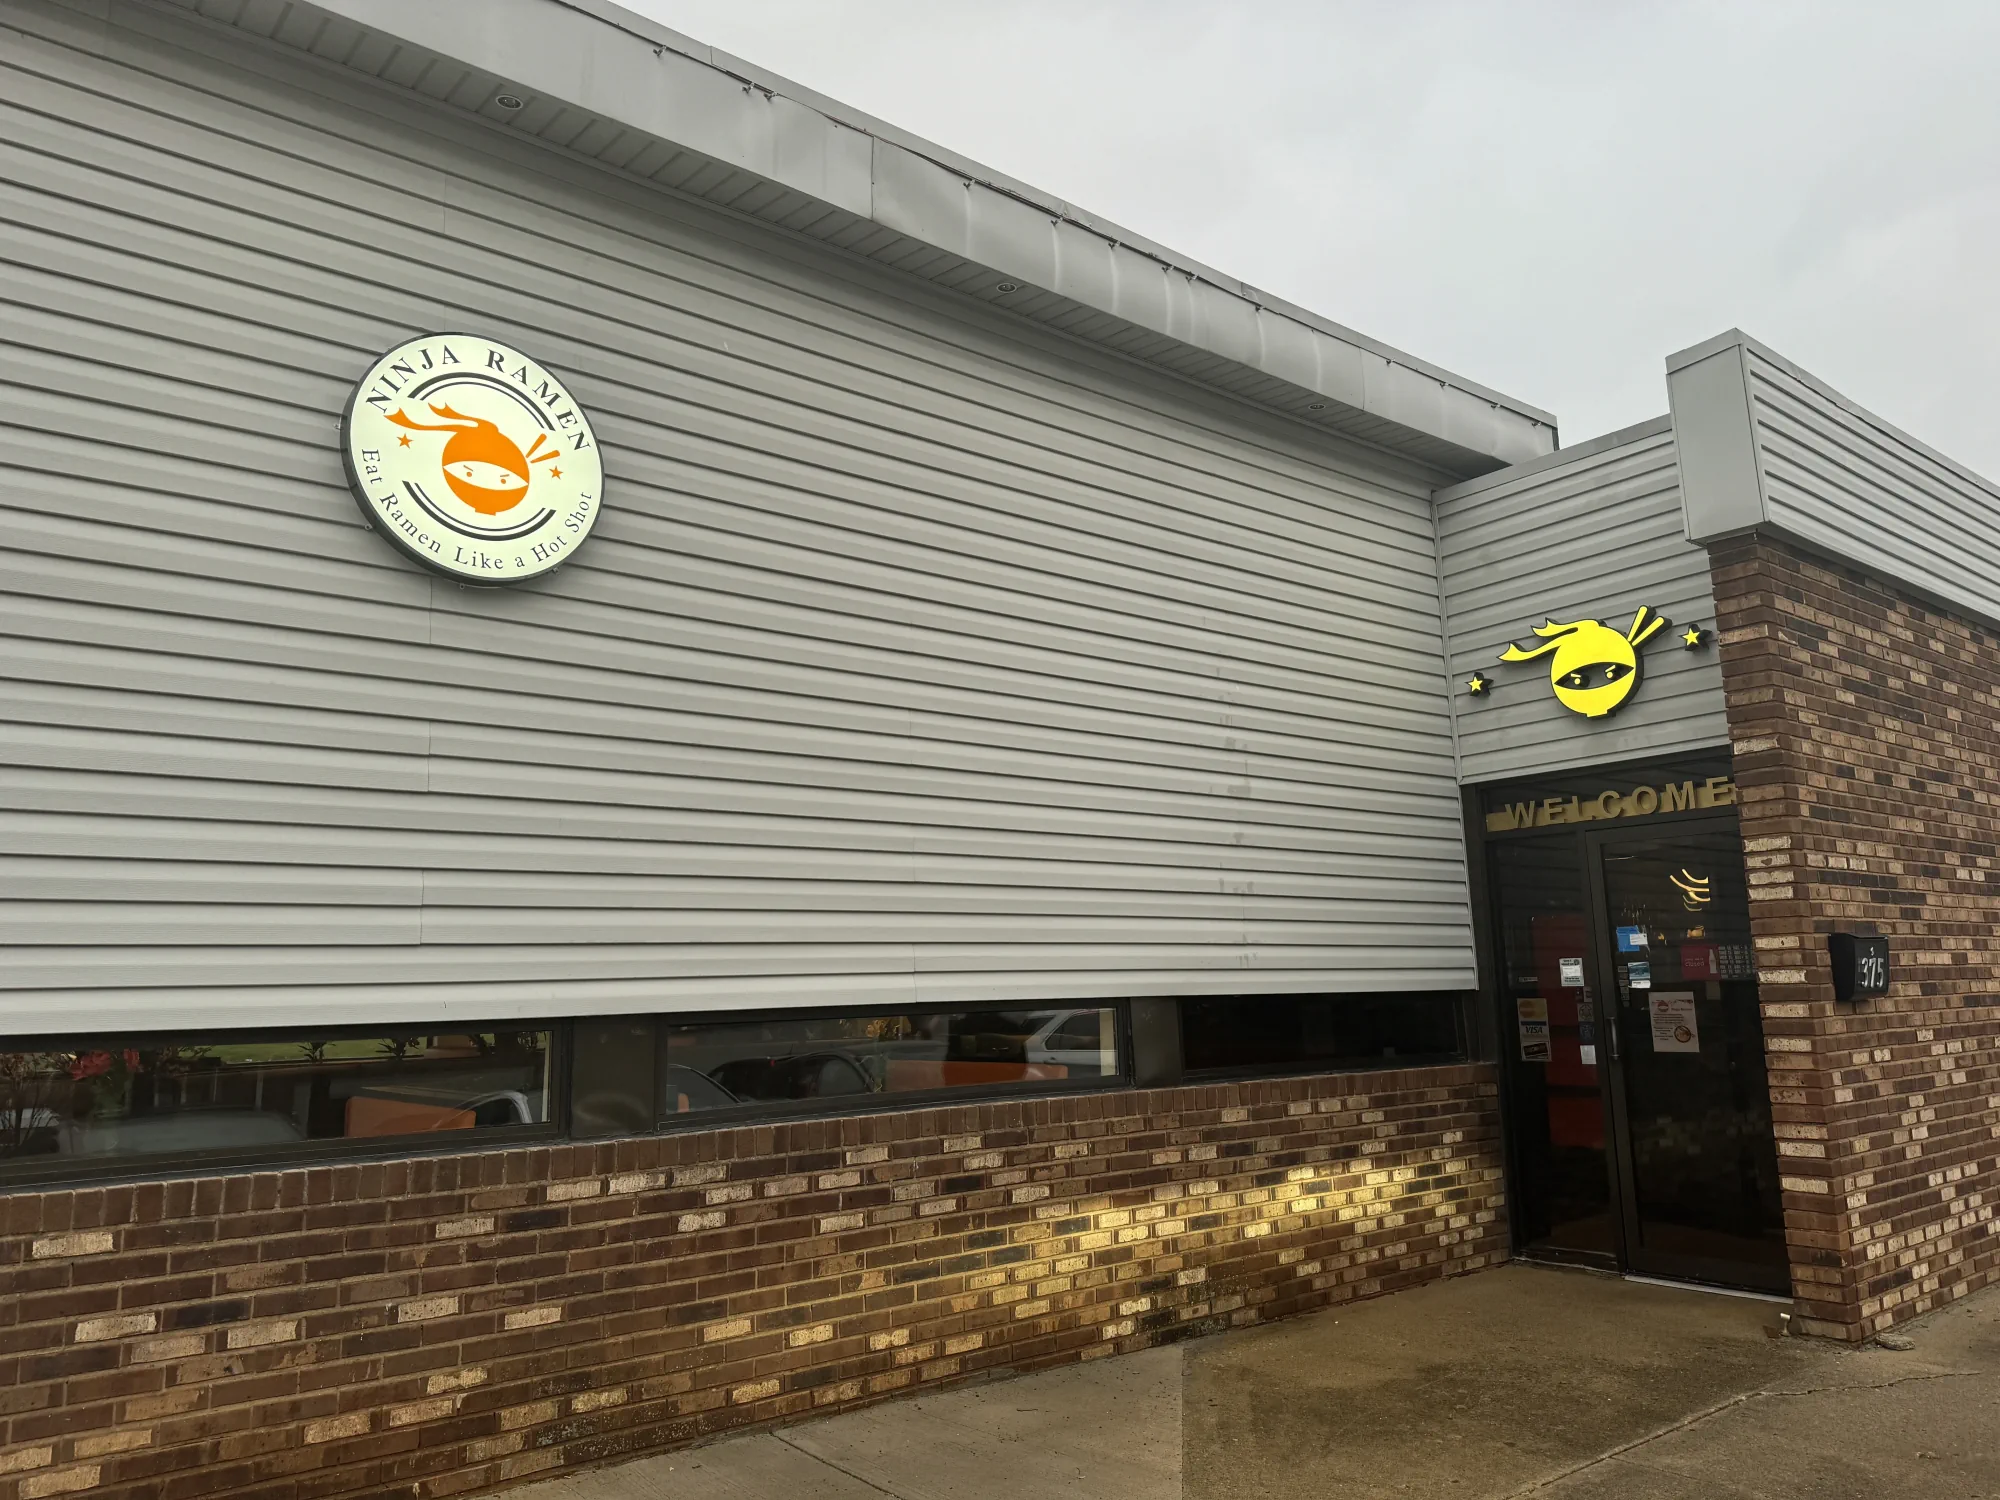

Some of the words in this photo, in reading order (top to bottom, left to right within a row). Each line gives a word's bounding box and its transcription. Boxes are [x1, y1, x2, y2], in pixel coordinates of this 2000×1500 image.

[365, 344, 461, 413] NINJA
[486, 348, 591, 452] RAMEN
[361, 448, 383, 484] Eat
[379, 493, 442, 554] Ramen
[454, 546, 504, 570] Like
[516, 556, 525, 568] a
[530, 534, 567, 563] Hot
[564, 492, 592, 533] Shot
[1505, 775, 1733, 829] WELCOME
[1861, 957, 1884, 988] 375
[1525, 1026, 1543, 1034] VISA
